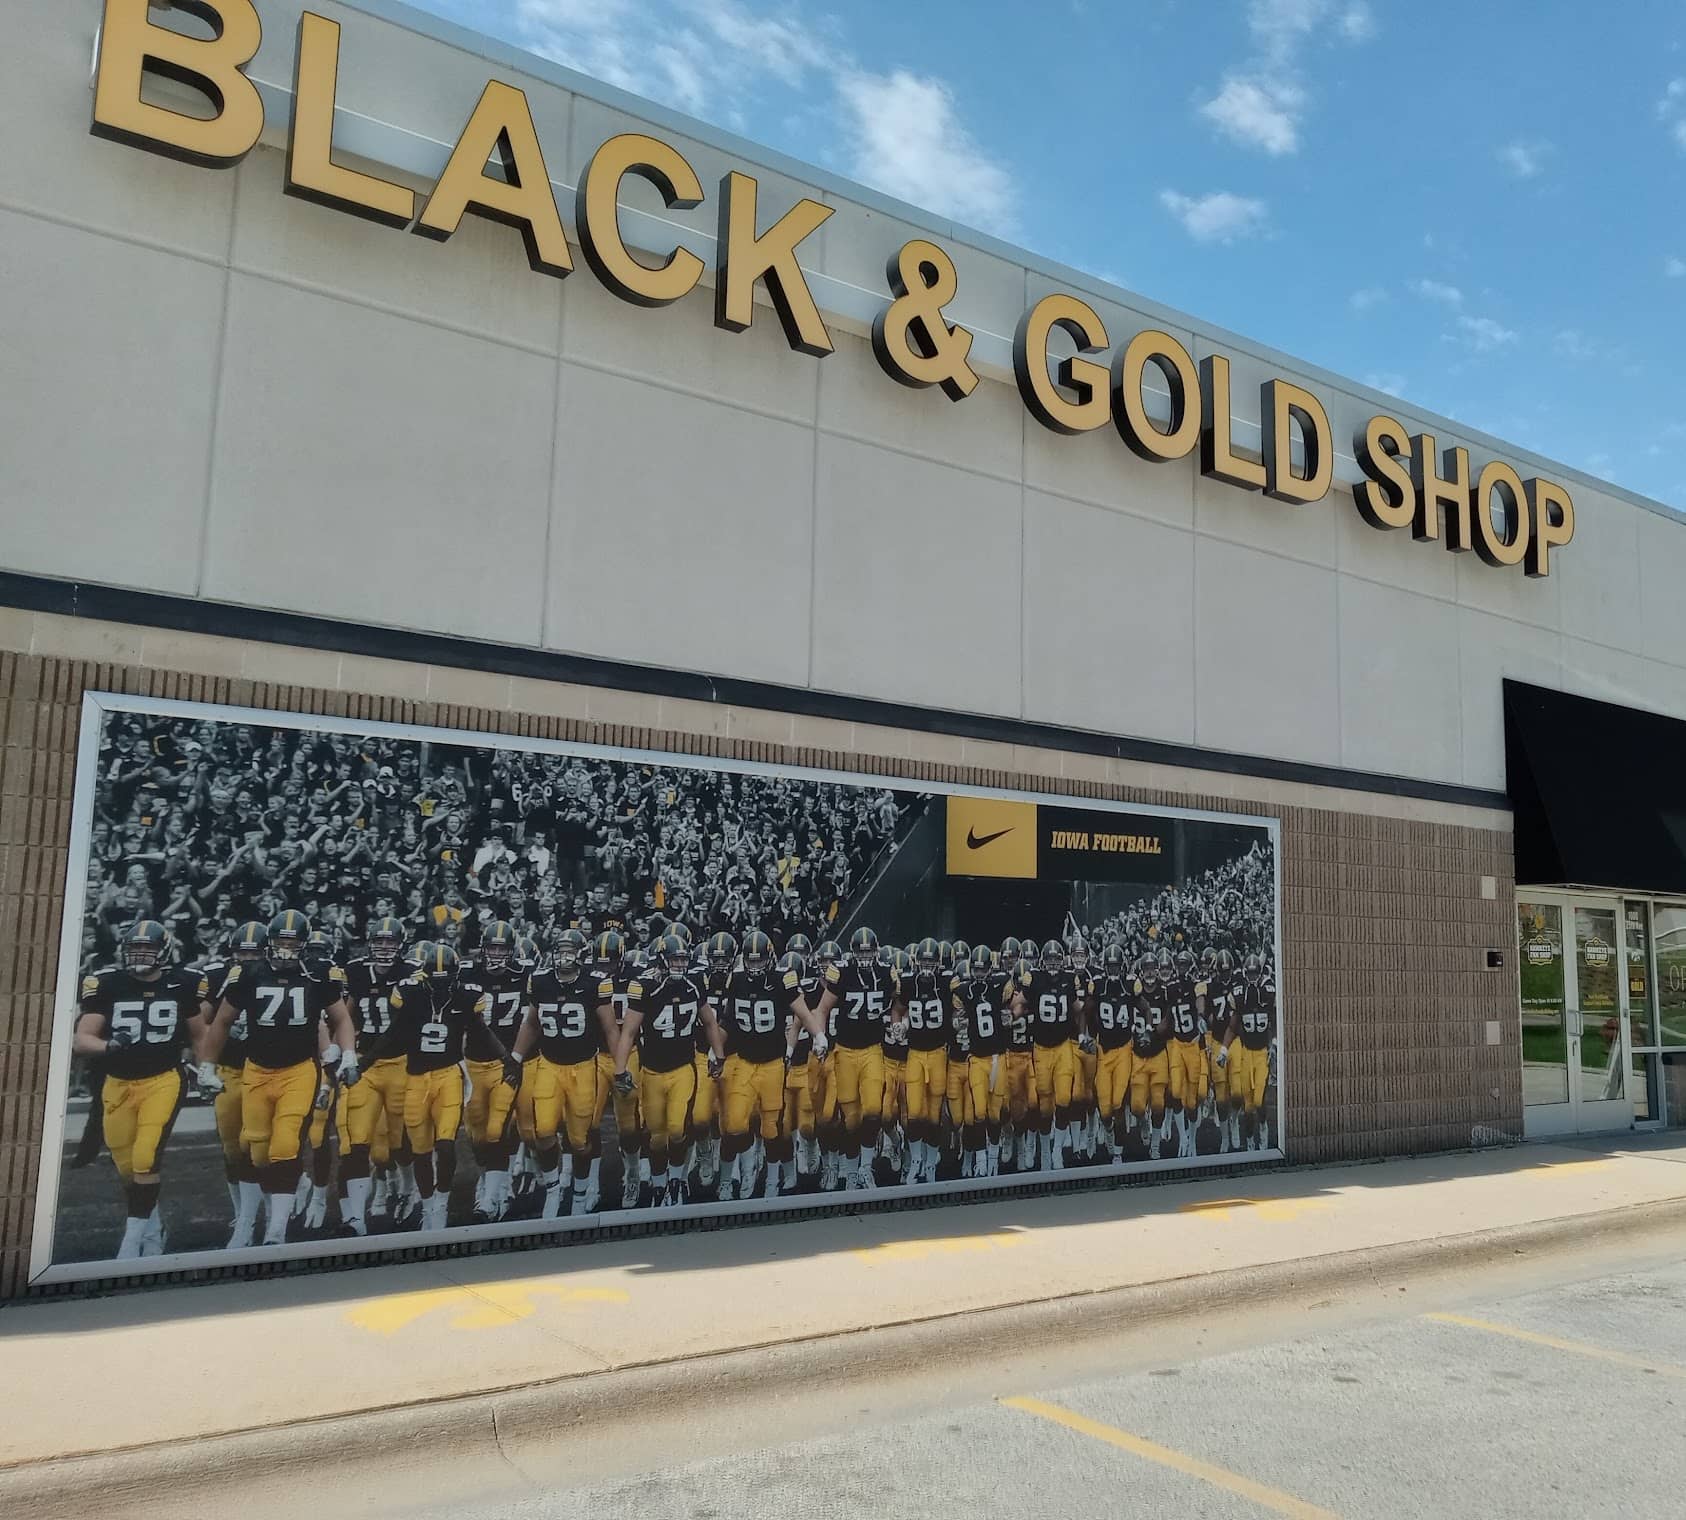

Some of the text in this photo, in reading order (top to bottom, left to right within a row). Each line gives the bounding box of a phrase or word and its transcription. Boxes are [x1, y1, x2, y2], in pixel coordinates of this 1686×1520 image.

[90, 0, 1575, 578] BLACK & GOLD SHOP
[1050, 830, 1162, 855] IOWA FOOTBALL
[111, 1000, 178, 1044] 59
[255, 986, 308, 1027] 71
[537, 1002, 586, 1038] 53
[652, 1000, 698, 1039] 47
[734, 997, 776, 1034] 58
[844, 990, 885, 1021] 75
[908, 999, 944, 1030] 83
[975, 1001, 995, 1038] 6
[1038, 993, 1068, 1023] 61
[1099, 1001, 1130, 1030] 94
[1171, 1003, 1194, 1034] 15
[419, 1022, 449, 1053] 2
